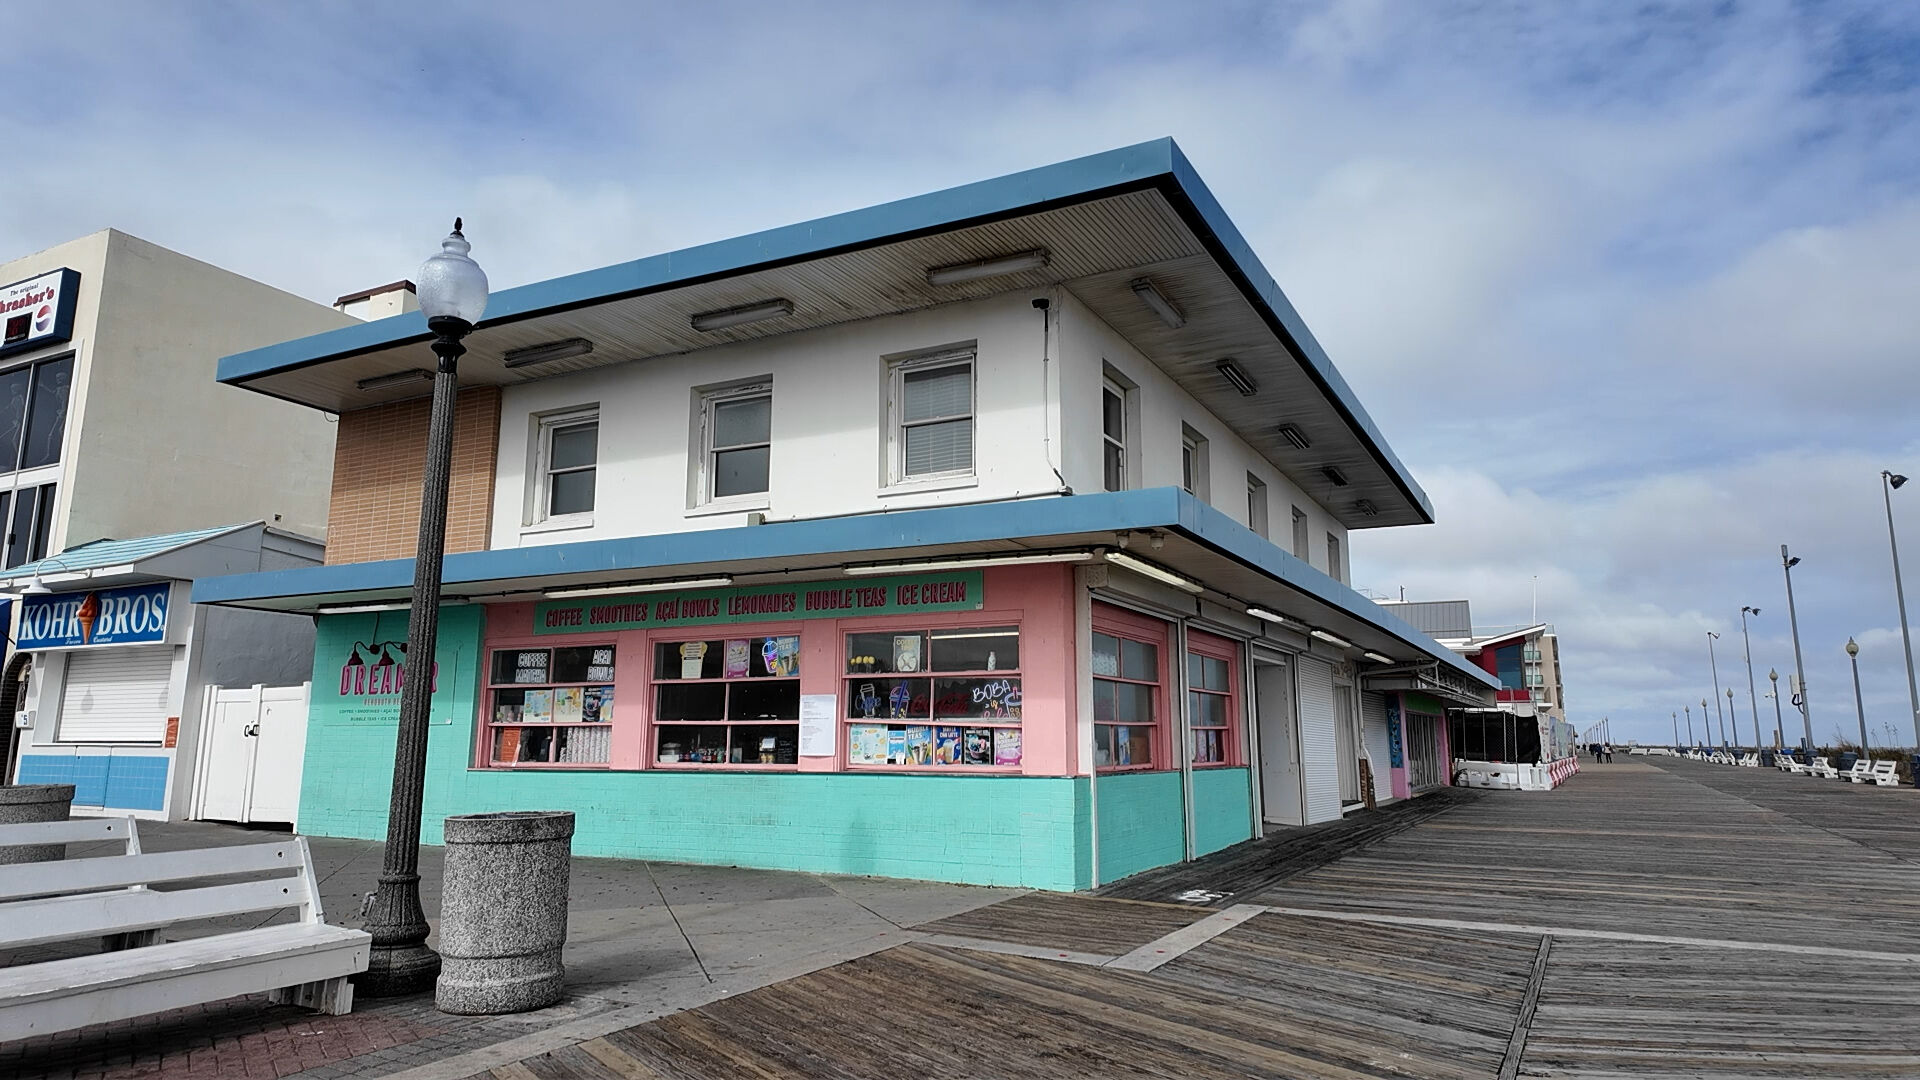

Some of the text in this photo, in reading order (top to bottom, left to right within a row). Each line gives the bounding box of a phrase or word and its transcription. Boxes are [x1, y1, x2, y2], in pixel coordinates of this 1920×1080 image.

[546, 607, 583, 628] COFFEE
[589, 603, 649, 625] SMOOTHIES
[682, 598, 720, 618] BOWLS
[728, 592, 797, 616] LEMONADES
[805, 588, 852, 611] BUBBLE
[856, 586, 887, 608] TEAS
[897, 584, 919, 606] ICE
[921, 581, 967, 604] CREAM
[19, 601, 81, 641] KOHR
[517, 653, 547, 667] COFFEE
[587, 666, 615, 682] BOWLS
[973, 680, 1010, 703] BOBA
